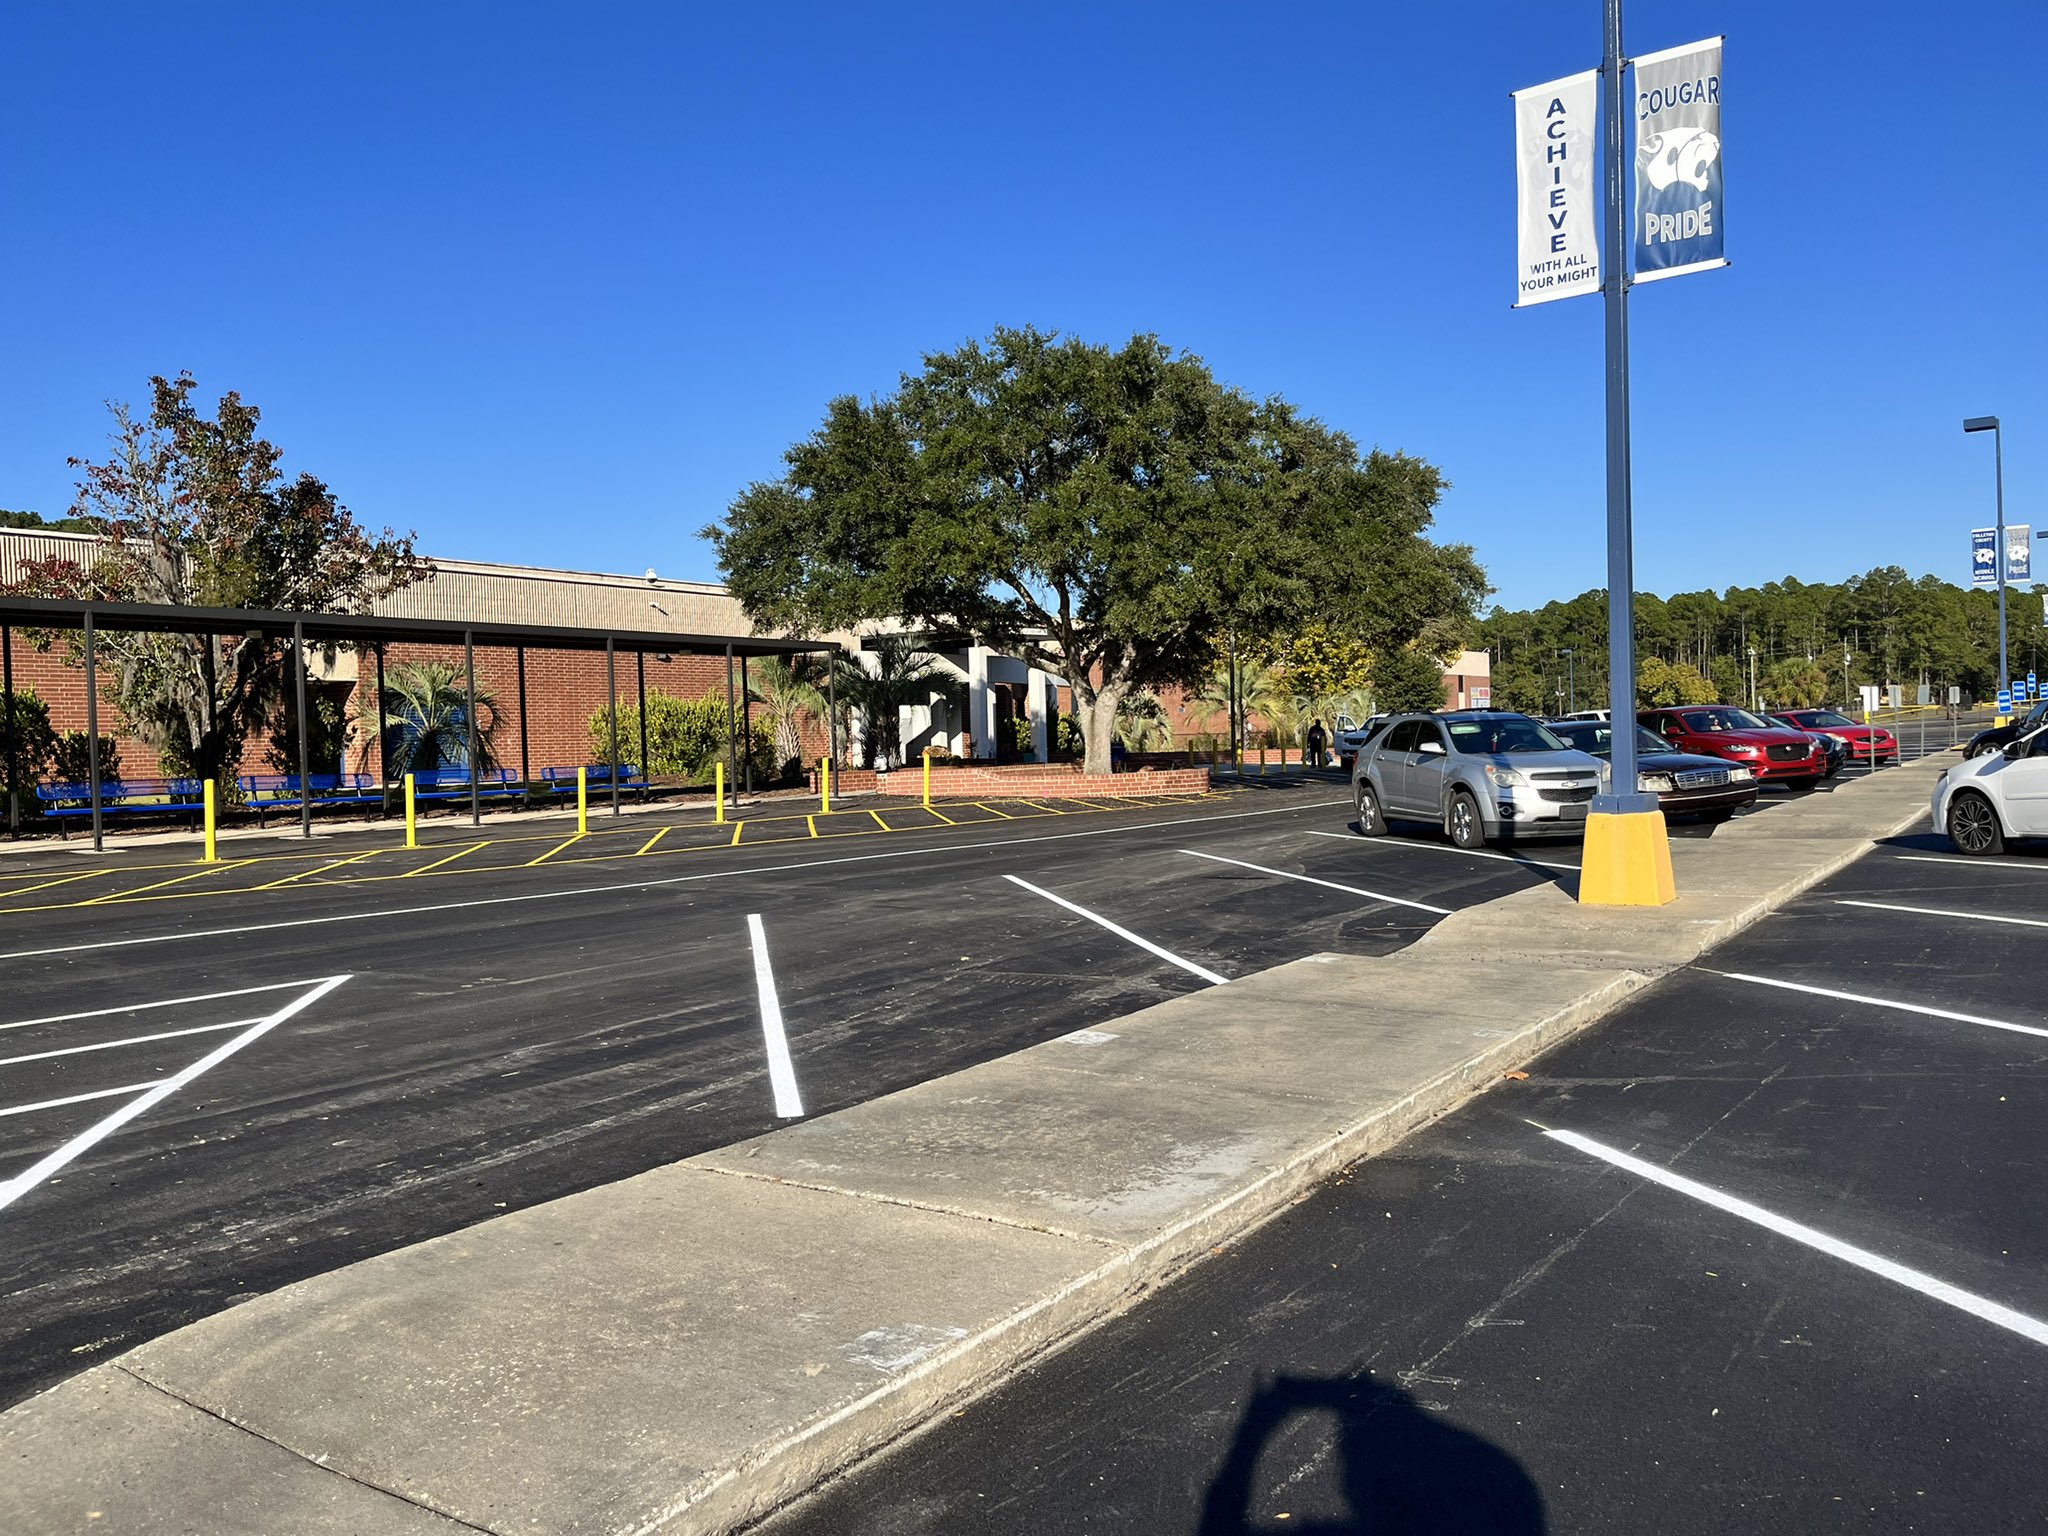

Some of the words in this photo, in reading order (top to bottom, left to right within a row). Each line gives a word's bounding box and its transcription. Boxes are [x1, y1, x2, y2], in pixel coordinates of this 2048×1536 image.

[1637, 75, 1720, 121] COUGAR
[1546, 97, 1567, 253] ACHIEVE
[1645, 200, 1713, 246] PRIDE
[1520, 276, 1554, 291] YOUR
[1557, 266, 1597, 284] MIGHT
[1530, 259, 1561, 275] WITH
[1565, 254, 1588, 268] ALL
